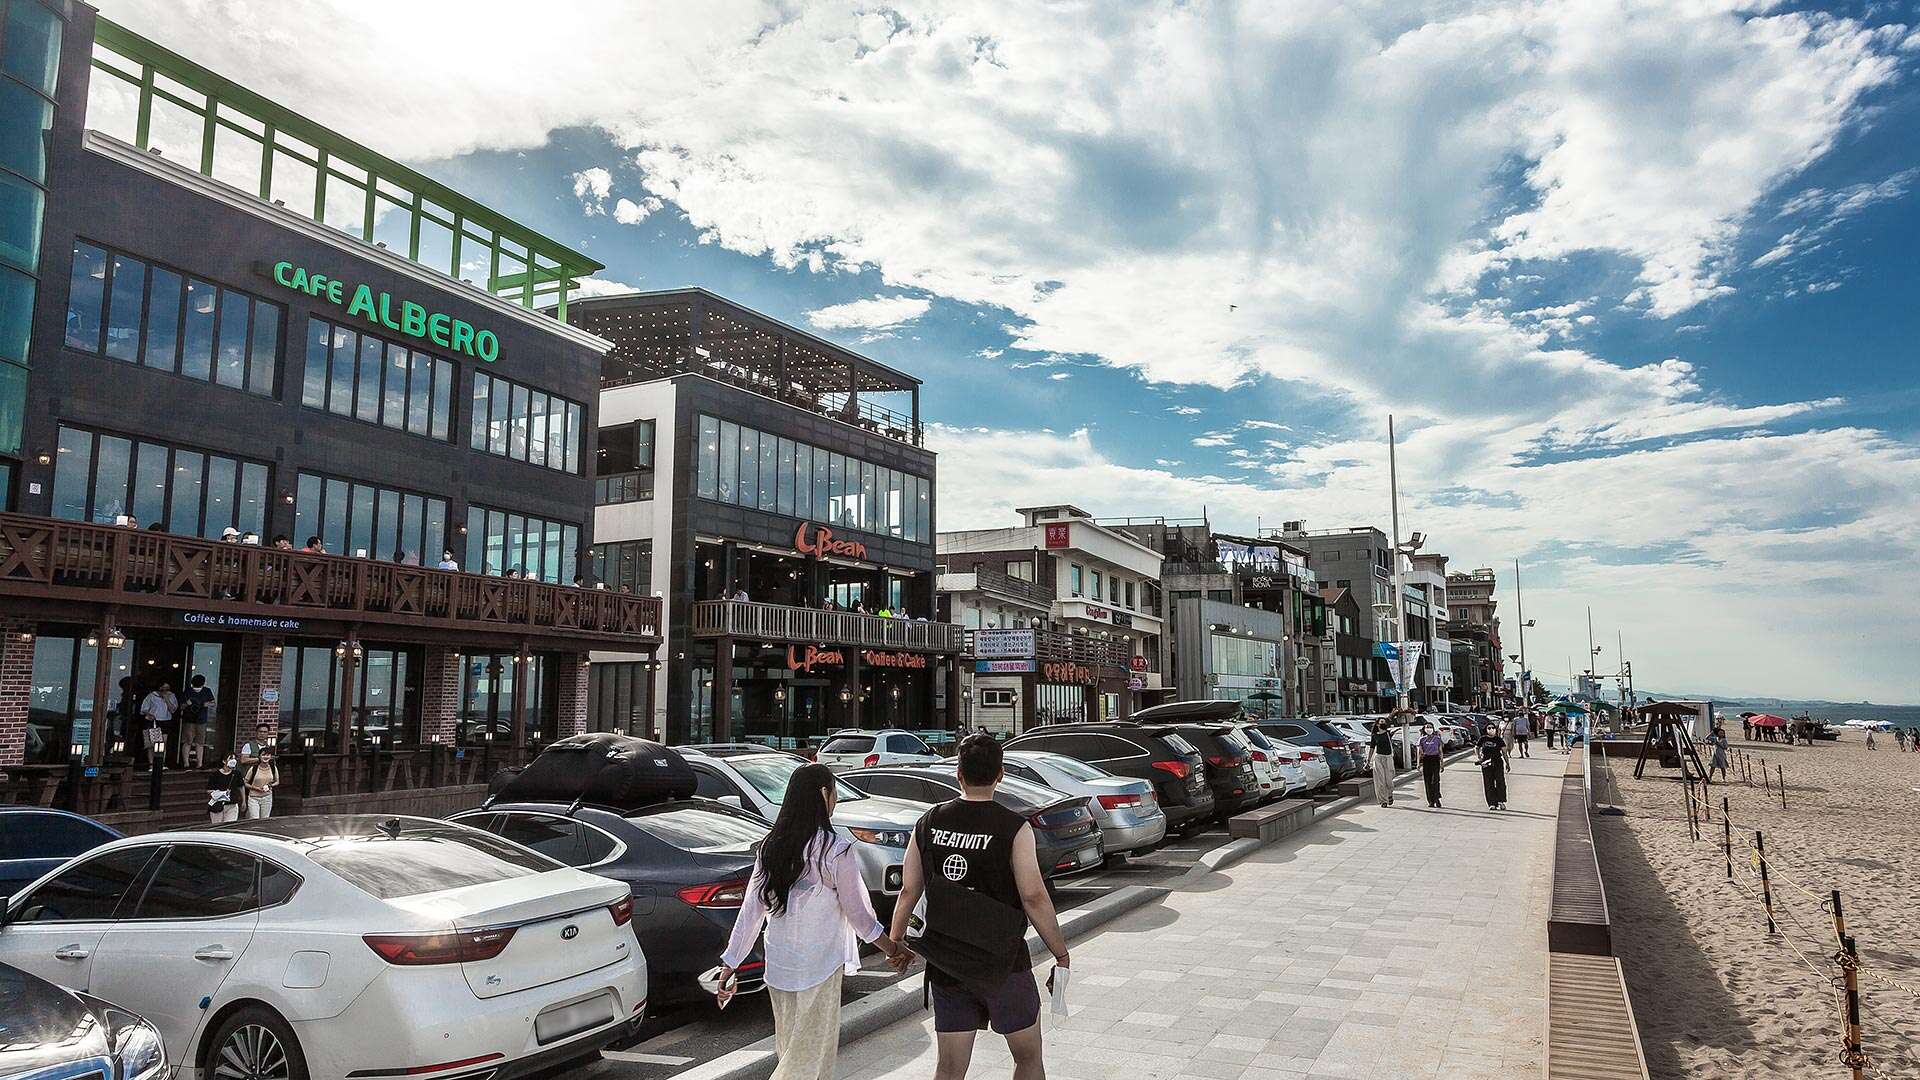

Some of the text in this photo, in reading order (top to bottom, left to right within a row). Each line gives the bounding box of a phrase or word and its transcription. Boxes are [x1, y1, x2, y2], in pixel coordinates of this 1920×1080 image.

[273, 261, 499, 363] CAFE ALBERO
[183, 613, 300, 629] Coffee & homemade cake
[866, 650, 896, 666] Coffee
[905, 653, 926, 668] Cake
[563, 928, 578, 938] KIA
